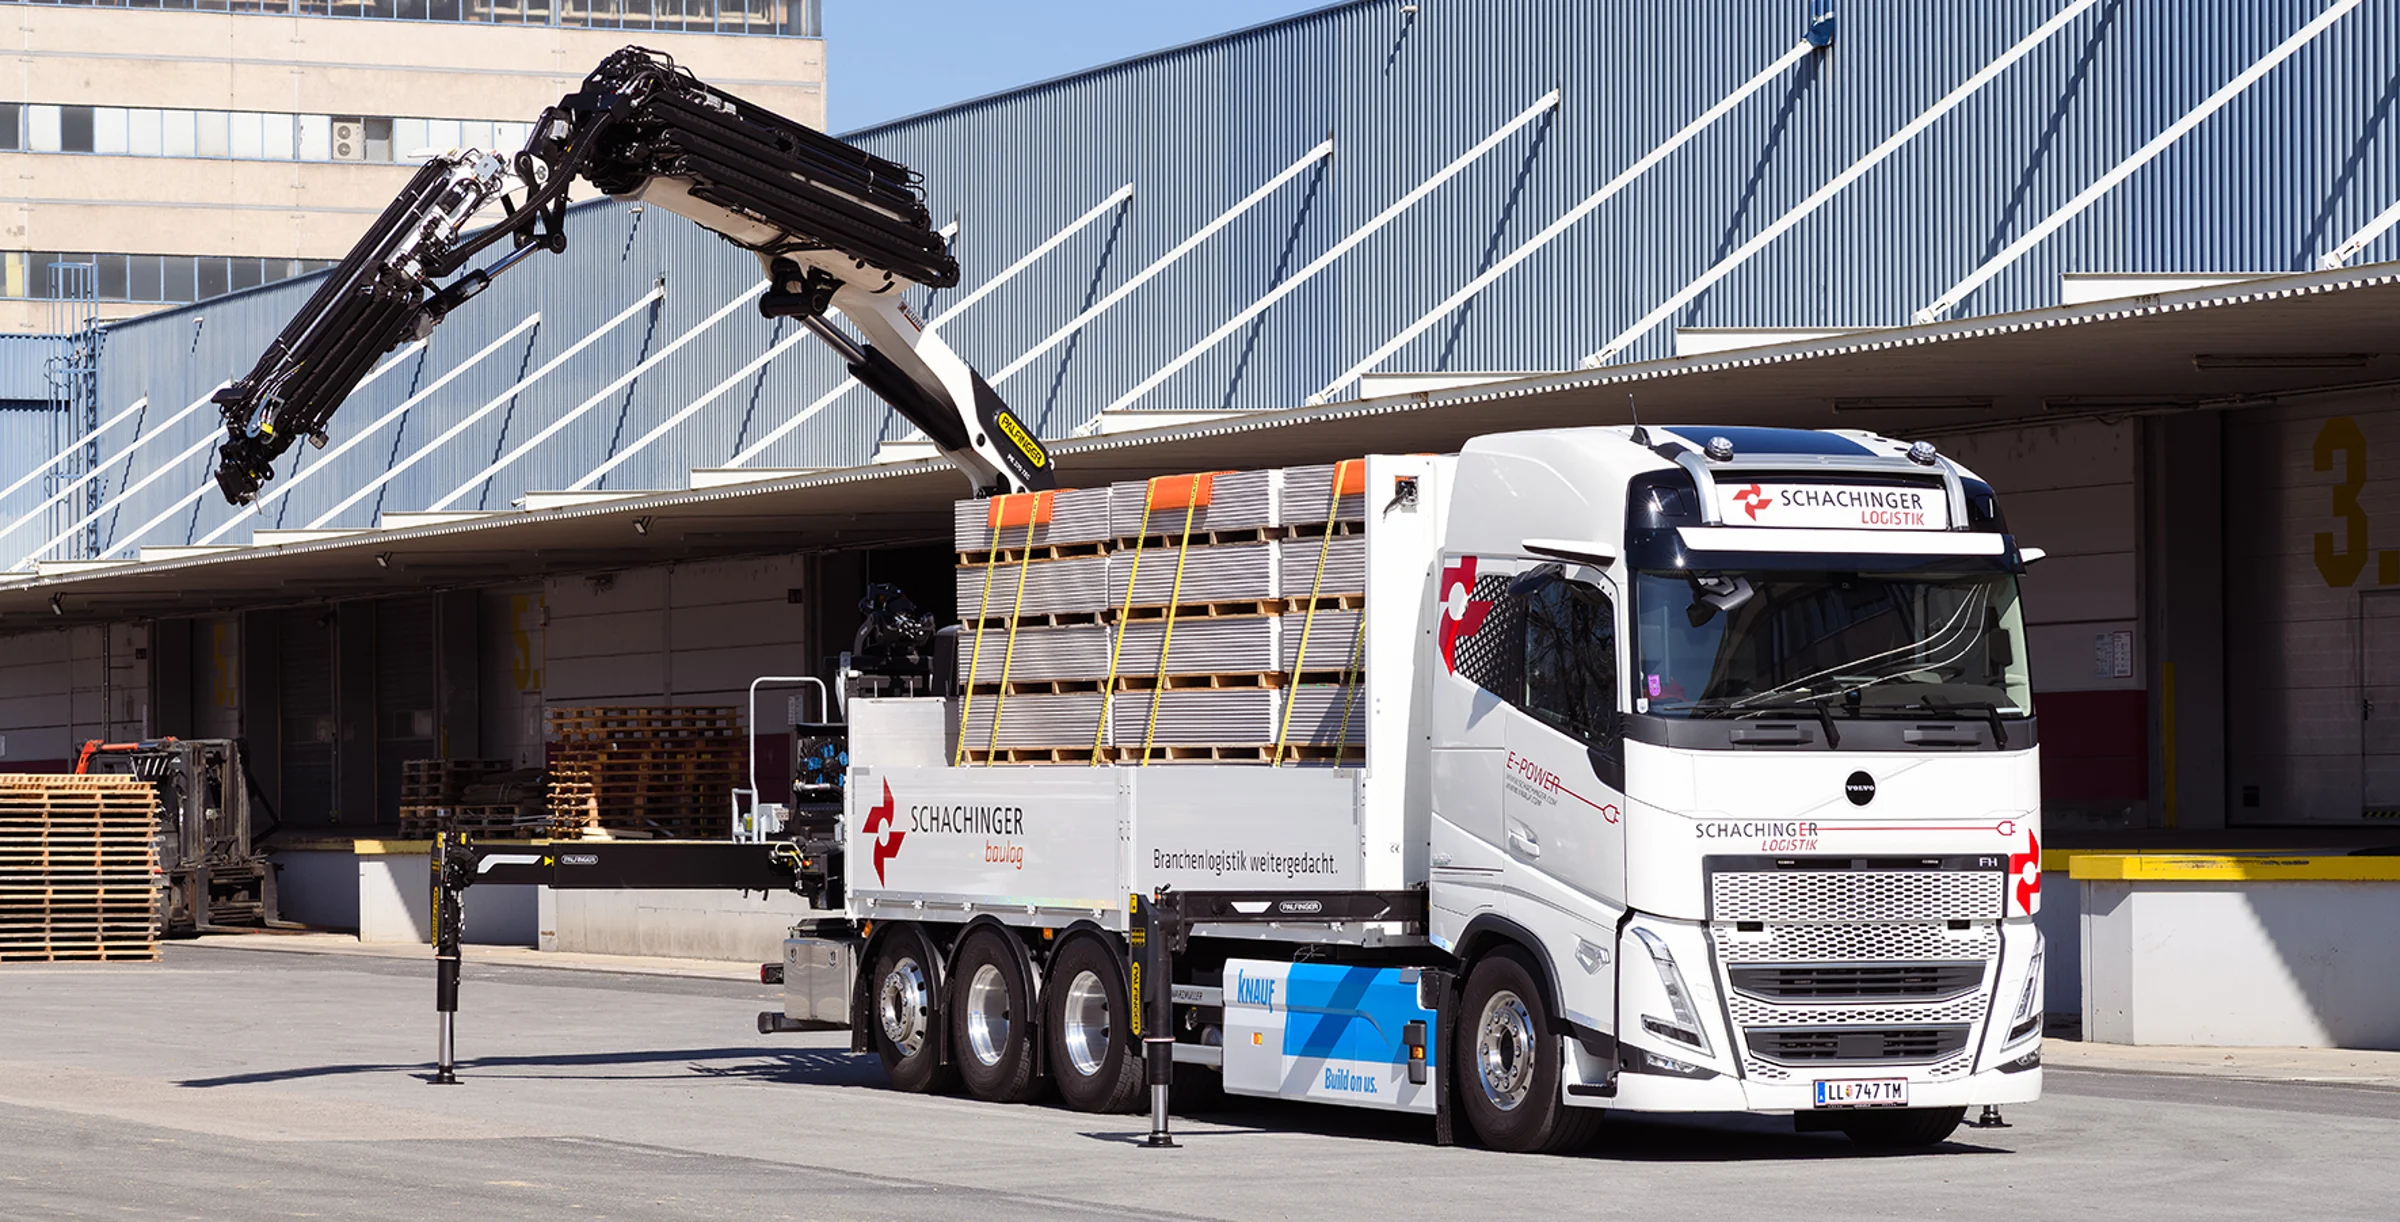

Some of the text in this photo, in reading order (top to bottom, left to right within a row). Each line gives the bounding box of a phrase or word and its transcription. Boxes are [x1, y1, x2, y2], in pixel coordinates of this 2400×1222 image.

[1000, 415, 1043, 464] PALFINGER
[1780, 489, 1923, 510] SCHACHINGER
[1861, 510, 1925, 526] LOGISTIK
[512, 595, 545, 690] 5.
[1506, 751, 1561, 795] E-POWER
[910, 805, 1024, 835] SCHACHINGER
[1695, 822, 1818, 838] SCHACHINGER
[985, 839, 1024, 871] baulog
[1761, 839, 1819, 852] LOGISTIK
[1153, 848, 1338, 879] Branchenlogistik weitergedacht.
[1979, 857, 1998, 867] FH
[1237, 968, 1275, 1014] KNAUF
[1324, 1067, 1377, 1093] Build on us.
[1828, 1084, 1844, 1101] LL
[1855, 1083, 1881, 1099] 747
[1884, 1083, 1902, 1099] TM
